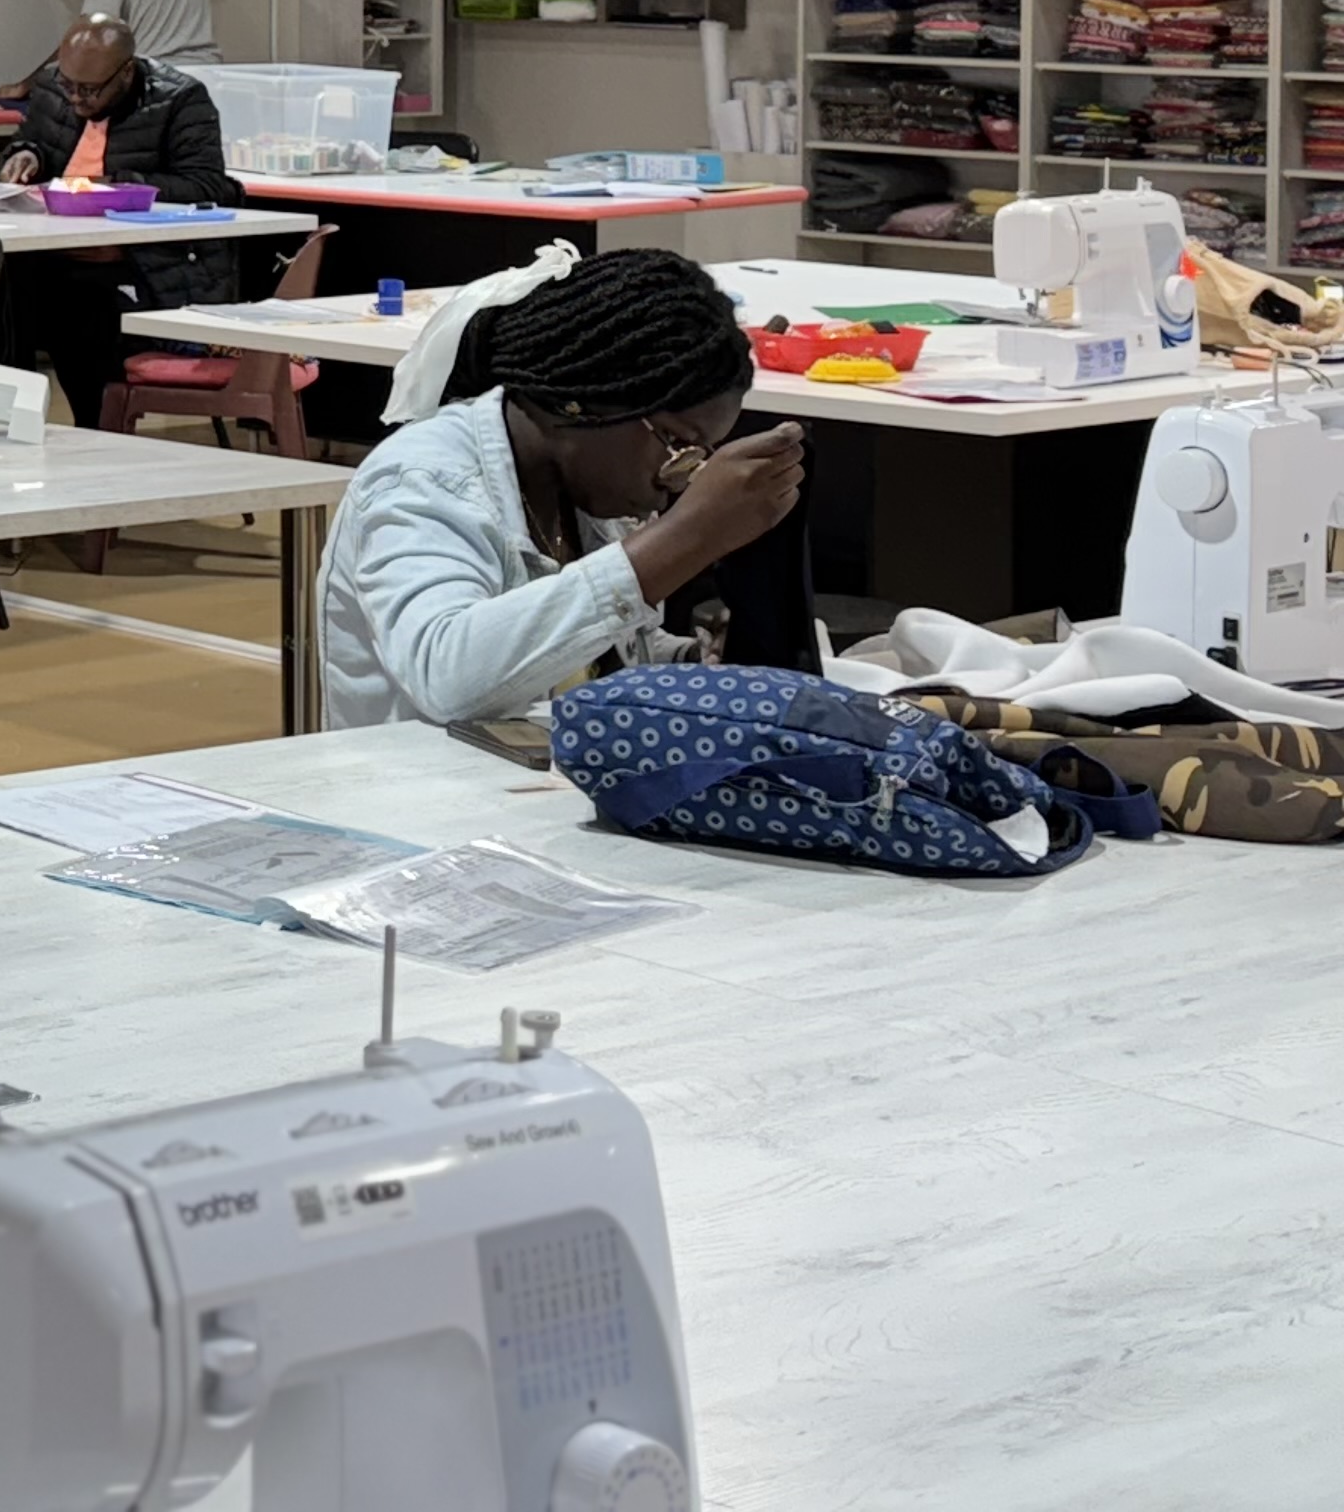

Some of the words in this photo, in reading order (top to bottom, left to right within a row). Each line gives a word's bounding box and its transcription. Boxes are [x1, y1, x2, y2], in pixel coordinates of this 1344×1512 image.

[464, 1133, 496, 1153] Sew
[499, 1127, 527, 1146] And
[177, 1189, 261, 1228] brother
